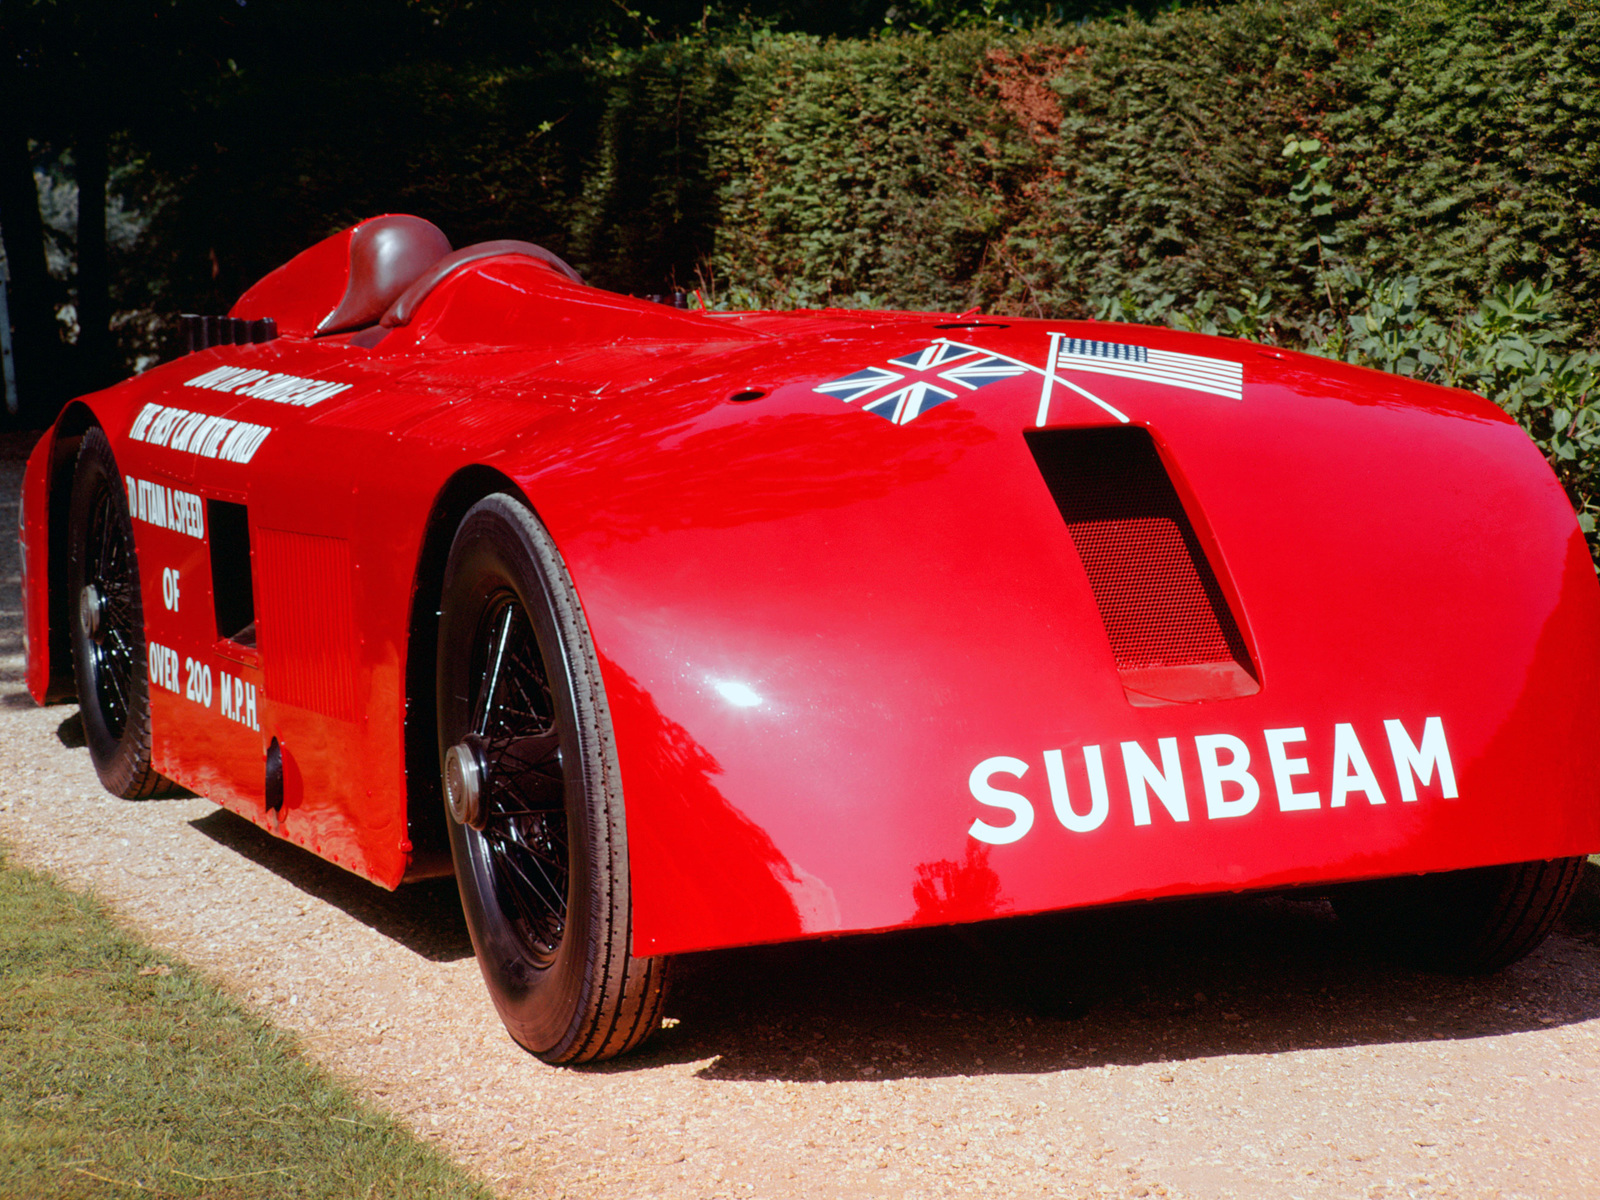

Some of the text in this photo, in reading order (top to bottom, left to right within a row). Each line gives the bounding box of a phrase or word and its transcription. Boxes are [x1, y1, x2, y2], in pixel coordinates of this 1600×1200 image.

[234, 372, 354, 408] SUNBEAM
[128, 402, 164, 441] THE
[170, 411, 207, 452] CAR
[188, 415, 221, 455] IN
[200, 417, 238, 459] THE
[218, 421, 272, 464] WORLD
[125, 474, 205, 540] TO ATTAIN A SPEED
[162, 566, 180, 612] OF
[148, 641, 261, 732] OVER 200 M.P.H.
[967, 715, 1459, 845] SUNBEAM
